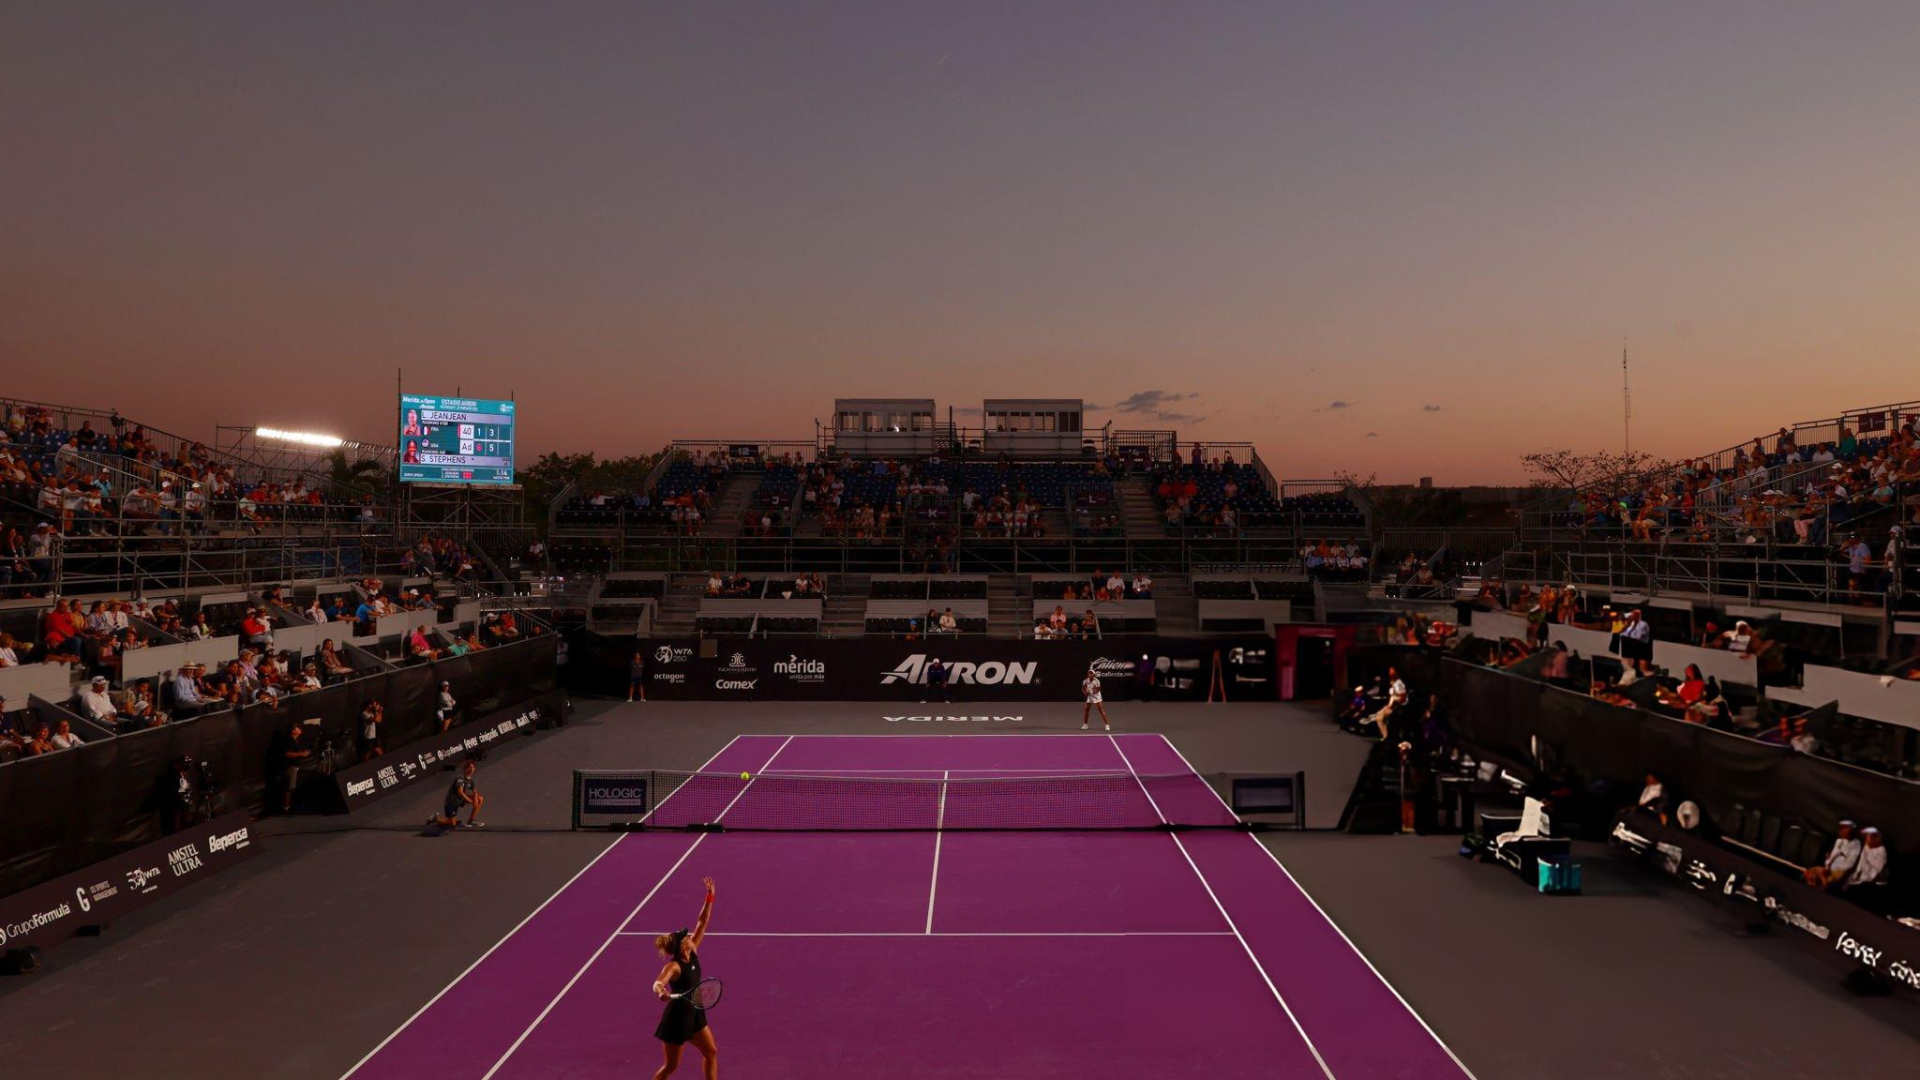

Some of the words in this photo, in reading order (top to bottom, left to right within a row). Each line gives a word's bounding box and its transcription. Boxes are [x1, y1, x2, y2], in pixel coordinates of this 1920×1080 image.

[430, 411, 467, 421] JEANJEAN
[462, 427, 472, 436] 40
[477, 428, 481, 436] 1
[489, 429, 494, 437] 3
[461, 443, 472, 451] Ad
[489, 444, 494, 452] 5
[429, 456, 467, 464] STEPHENS
[715, 679, 758, 690] Comex
[588, 787, 642, 799] HOLOGIC
[168, 843, 200, 866] AMSTEL
[172, 855, 204, 877] ULTRA
[6, 902, 71, 938] GrupoFórmula
